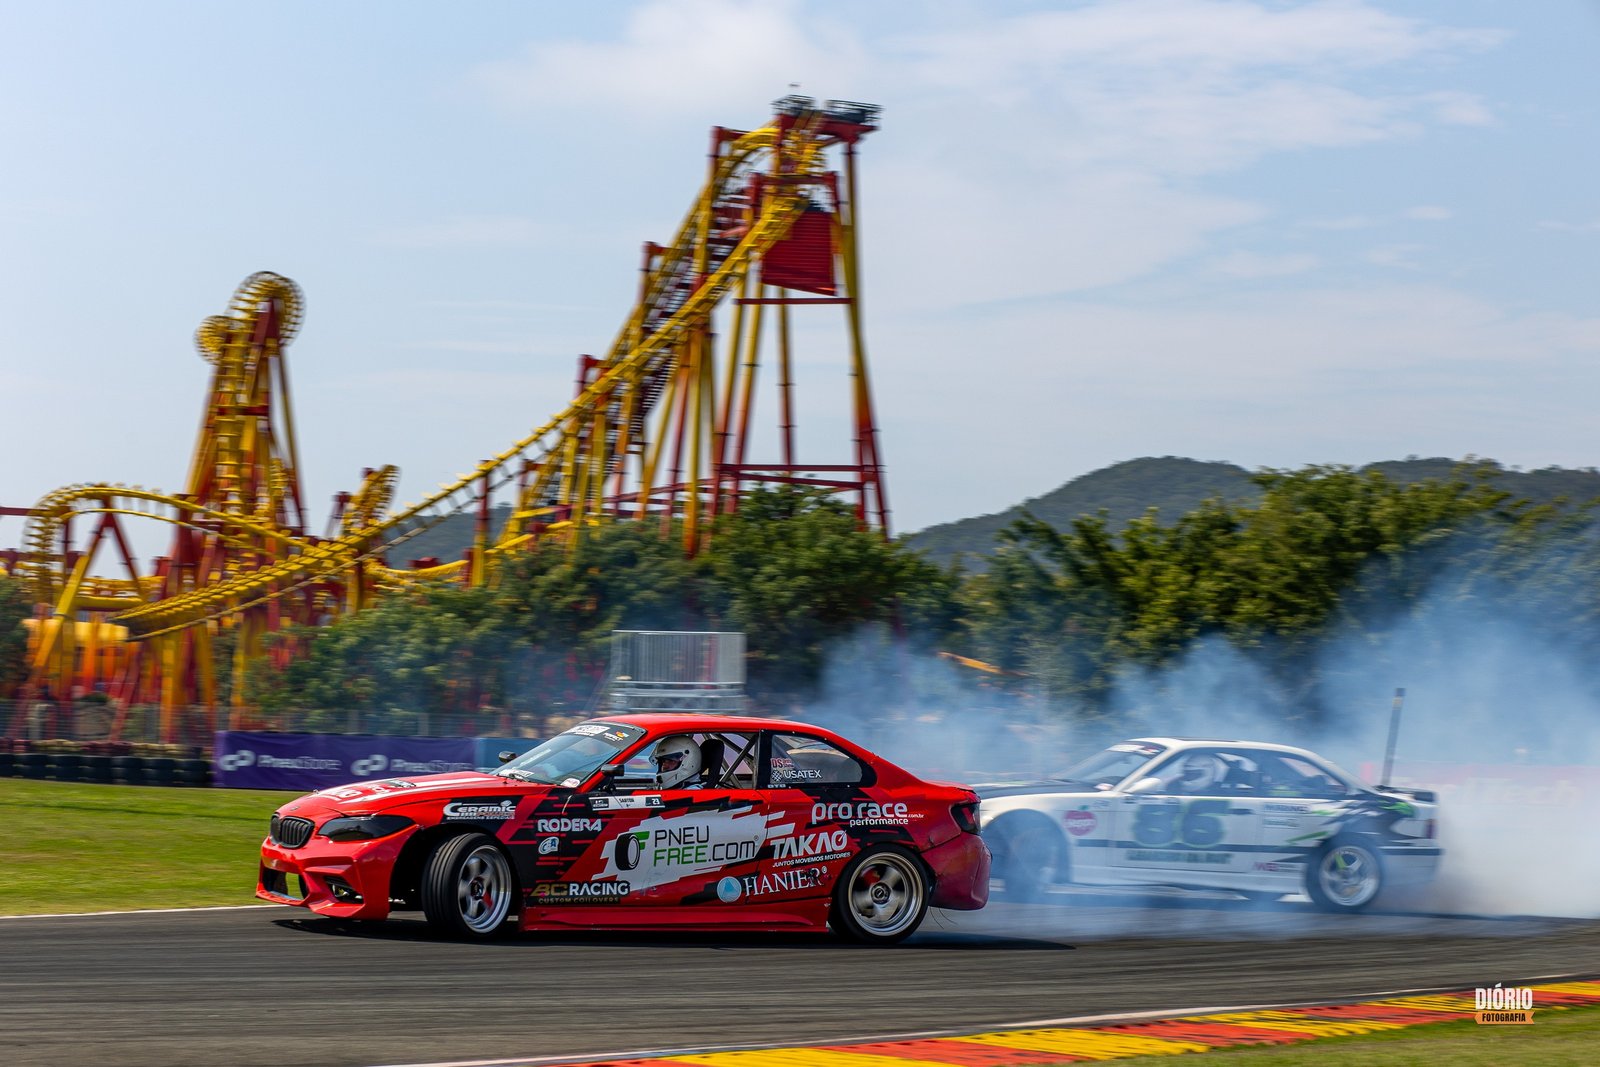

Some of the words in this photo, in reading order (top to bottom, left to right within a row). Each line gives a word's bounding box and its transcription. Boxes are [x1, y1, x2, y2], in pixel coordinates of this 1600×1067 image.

[783, 769, 822, 779] USATEX
[811, 802, 853, 825] pro
[856, 802, 908, 819] race
[849, 817, 909, 827] performance
[1133, 799, 1231, 848] 86
[654, 825, 709, 848] PNEU
[770, 829, 848, 860] TAKAO
[794, 855, 824, 864] MOVEMOS
[824, 851, 851, 861] MOTORES
[569, 882, 629, 896] RACING
[743, 867, 824, 897] HANIER
